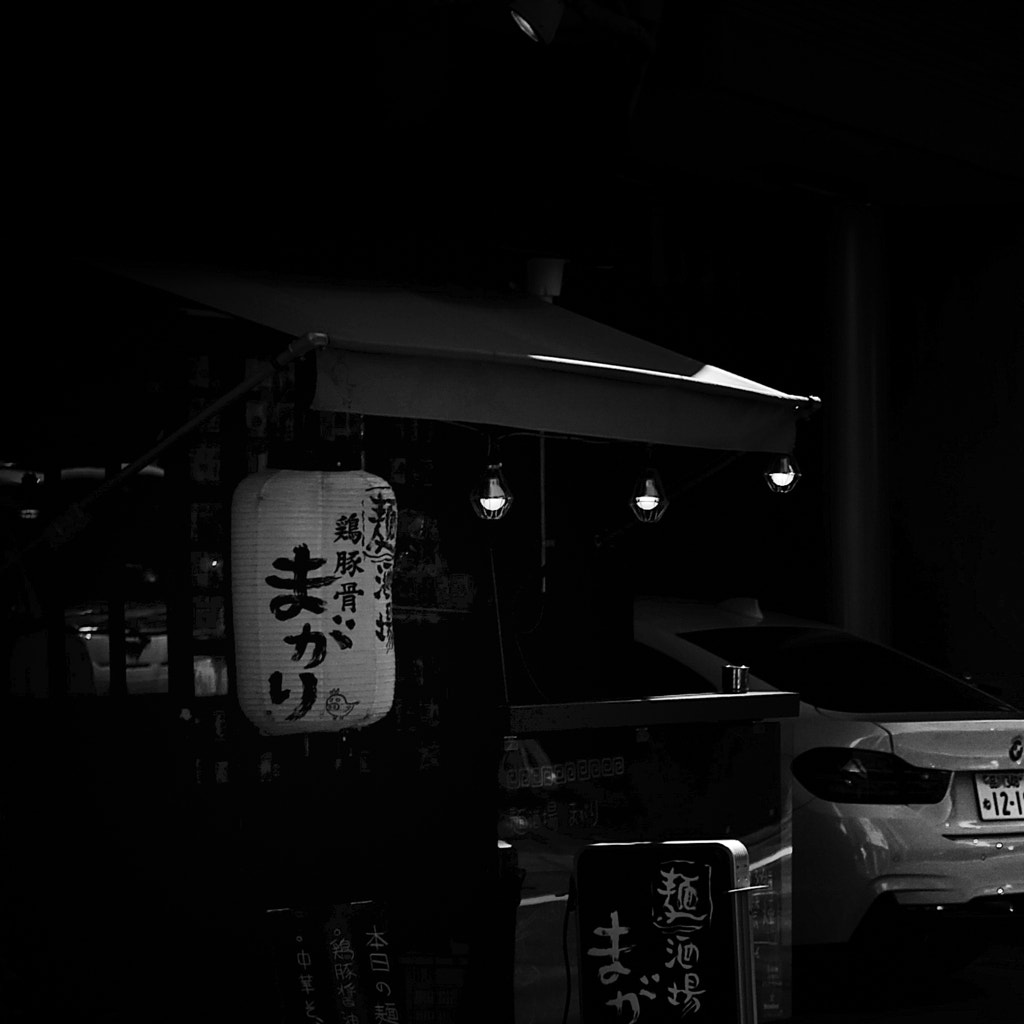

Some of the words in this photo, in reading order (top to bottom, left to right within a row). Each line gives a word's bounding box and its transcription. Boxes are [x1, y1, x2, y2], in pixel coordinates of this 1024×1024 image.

[265, 543, 354, 722] まがり
[333, 512, 365, 613] 鶏豚骨
[656, 866, 708, 1018] 麺酒場
